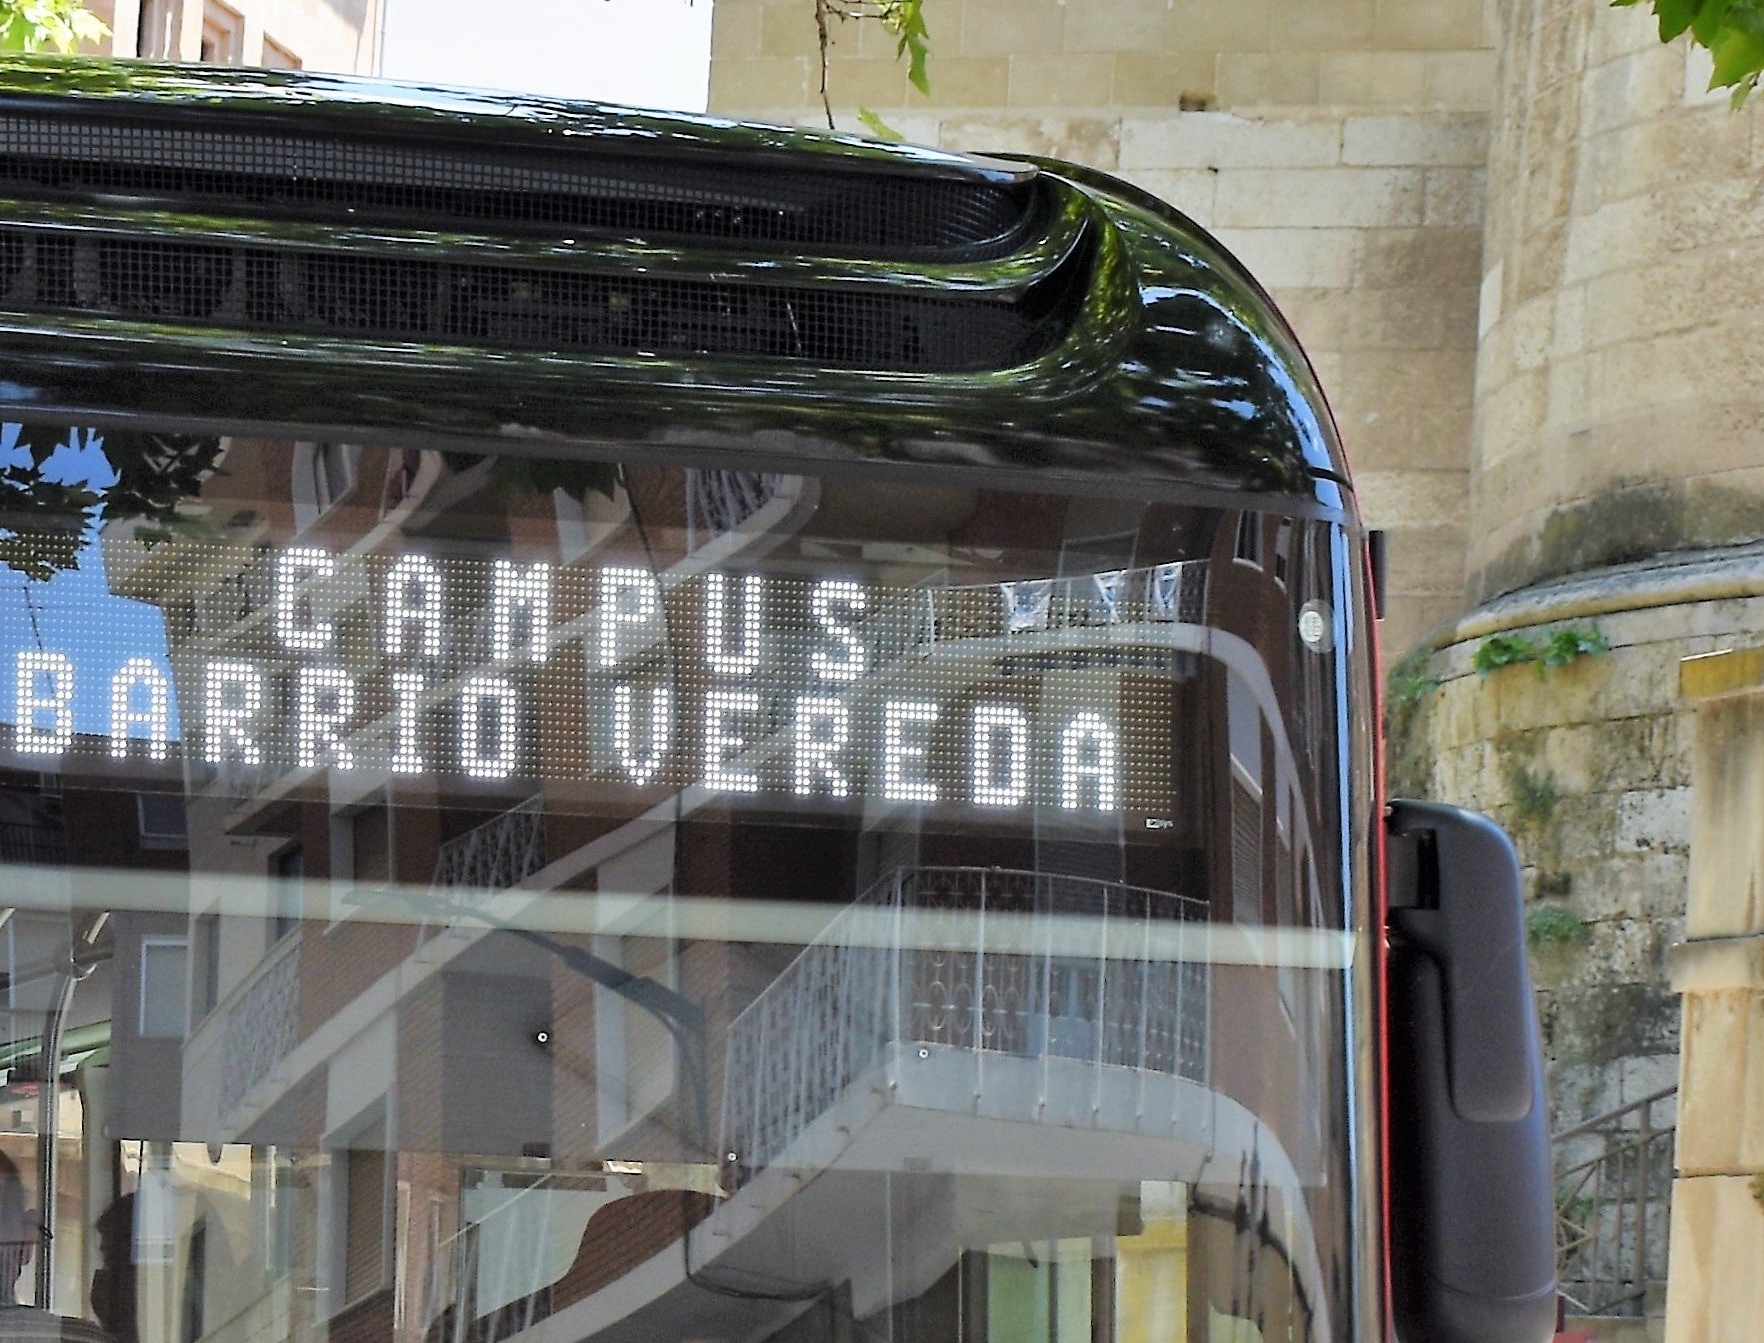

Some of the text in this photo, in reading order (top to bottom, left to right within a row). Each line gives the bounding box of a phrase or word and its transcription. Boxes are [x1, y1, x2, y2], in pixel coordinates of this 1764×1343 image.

[274, 547, 868, 684] CAMPUS
[14, 650, 1116, 814] BARRIO VEREDA
